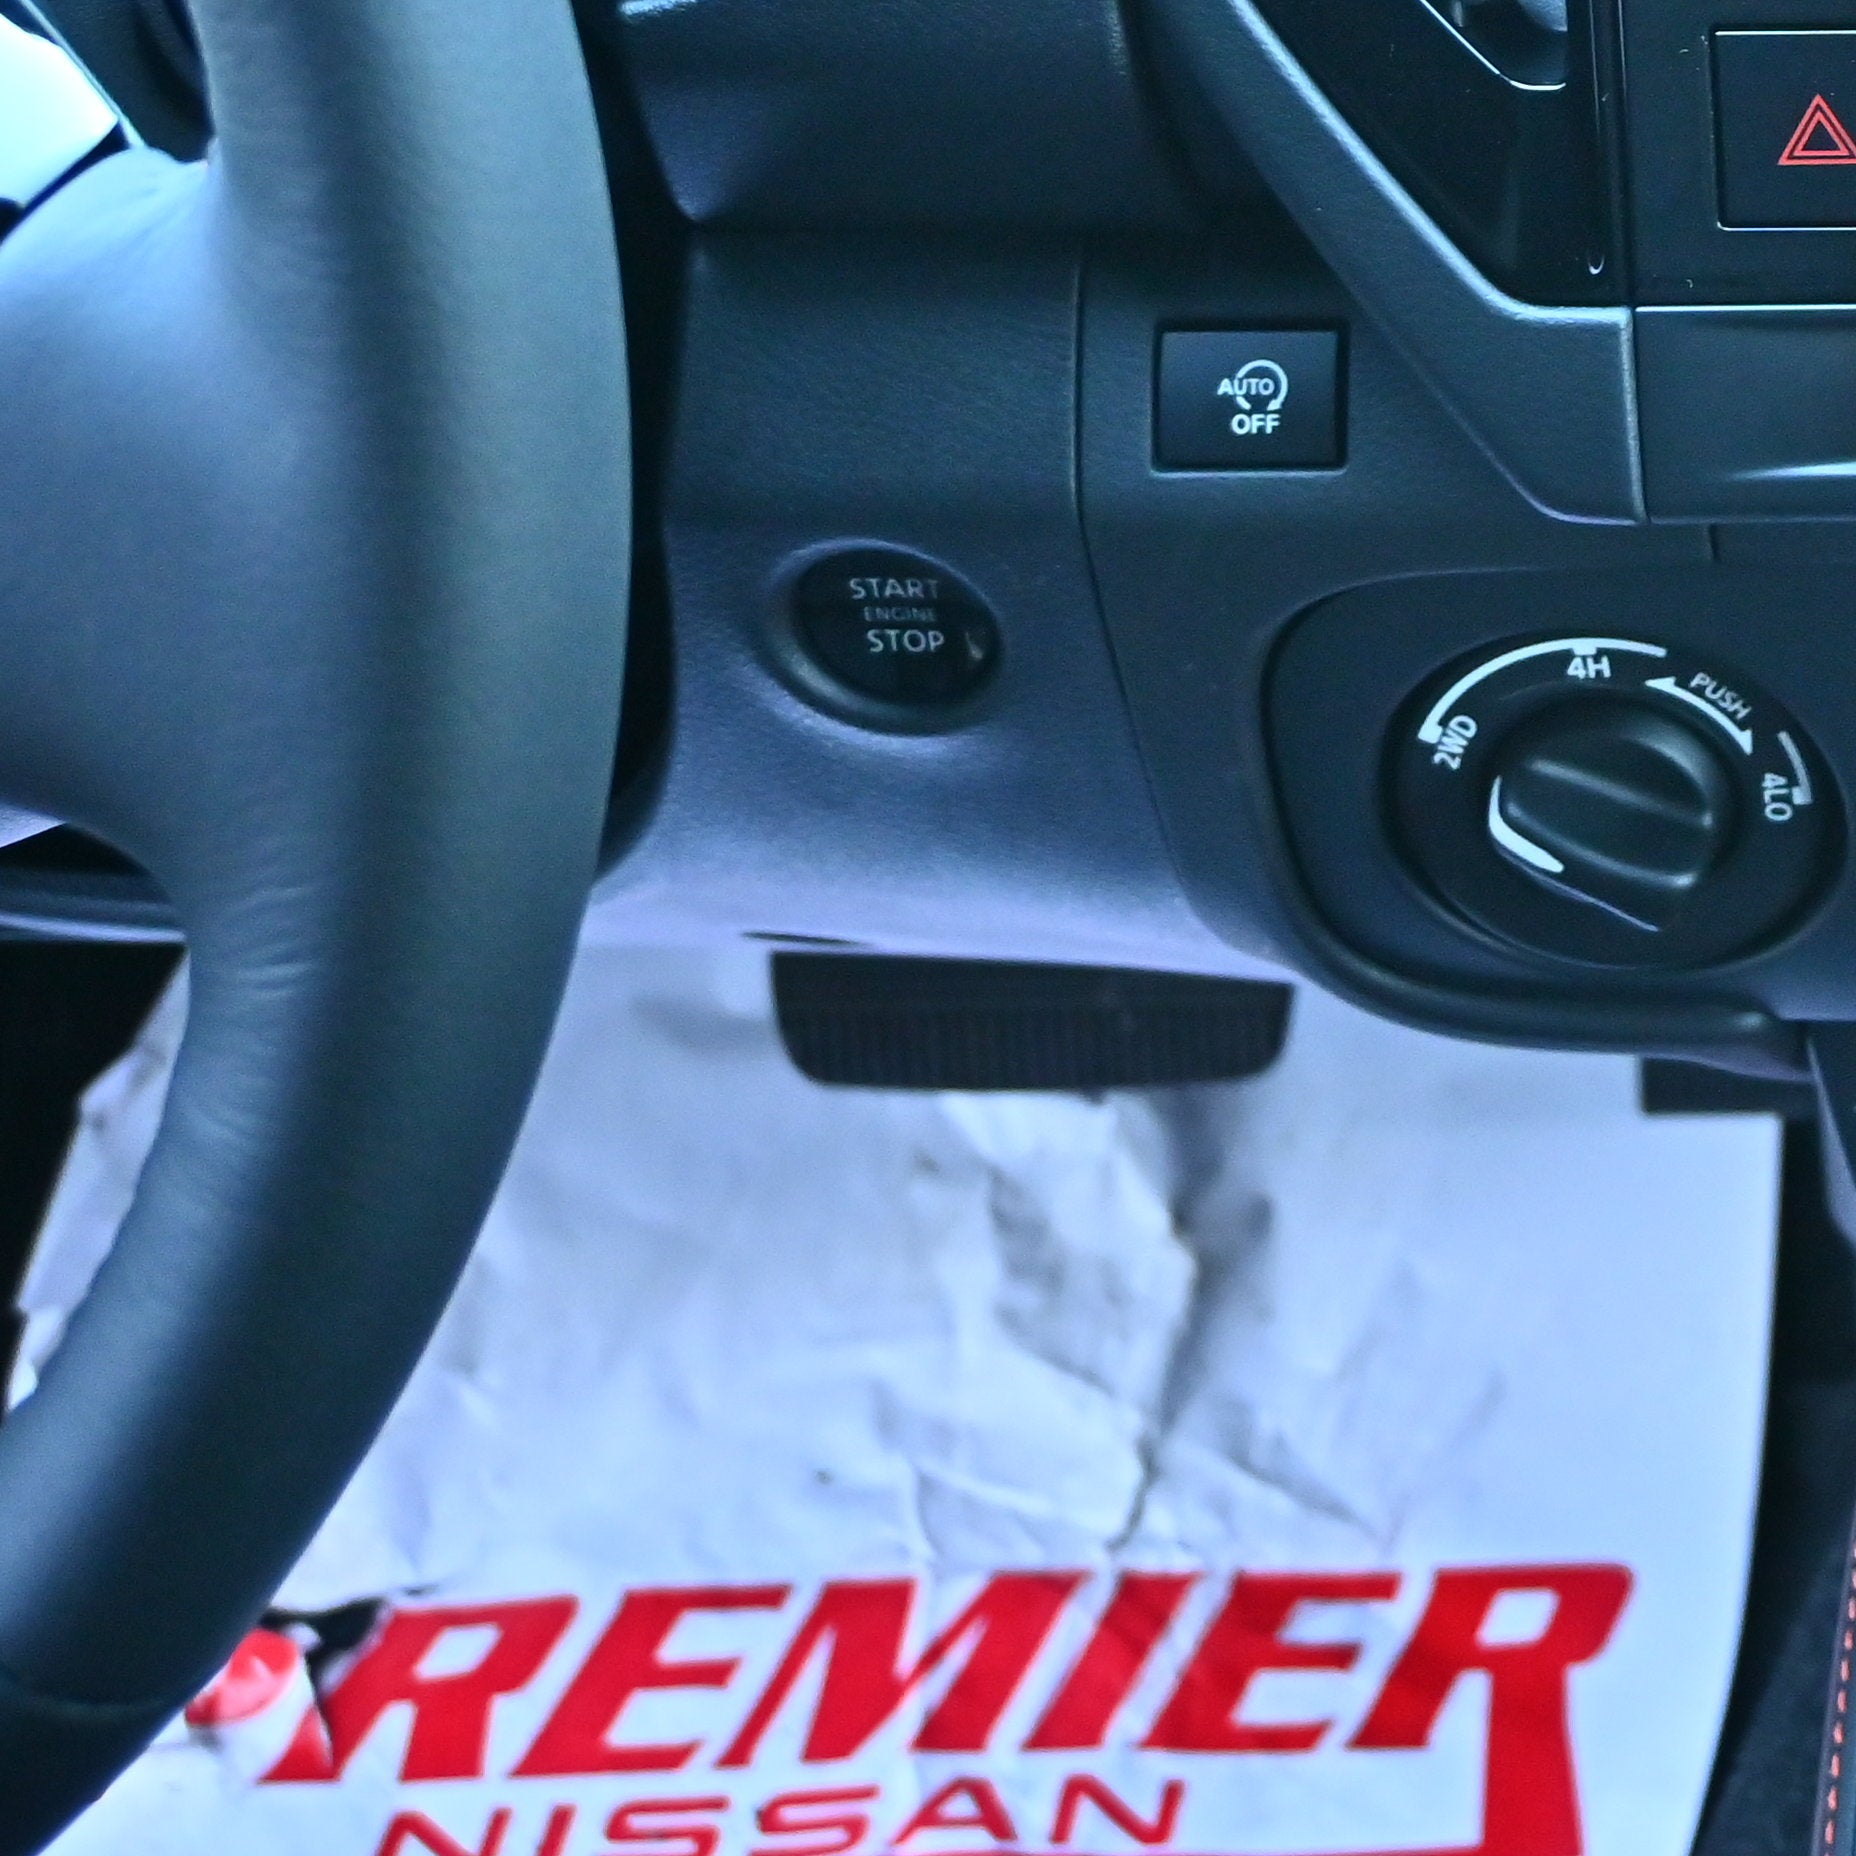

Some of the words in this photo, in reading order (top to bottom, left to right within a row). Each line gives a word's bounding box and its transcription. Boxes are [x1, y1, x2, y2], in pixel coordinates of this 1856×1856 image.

[1217, 378, 1276, 396] AUTO
[1230, 413, 1280, 435] OFF
[849, 577, 940, 601] START
[866, 628, 946, 653] STOP
[1566, 656, 1612, 679] 4H
[1690, 672, 1752, 721] PUSH
[1432, 714, 1479, 771] 2WD
[374, 1772, 1184, 1856] NISSAN
